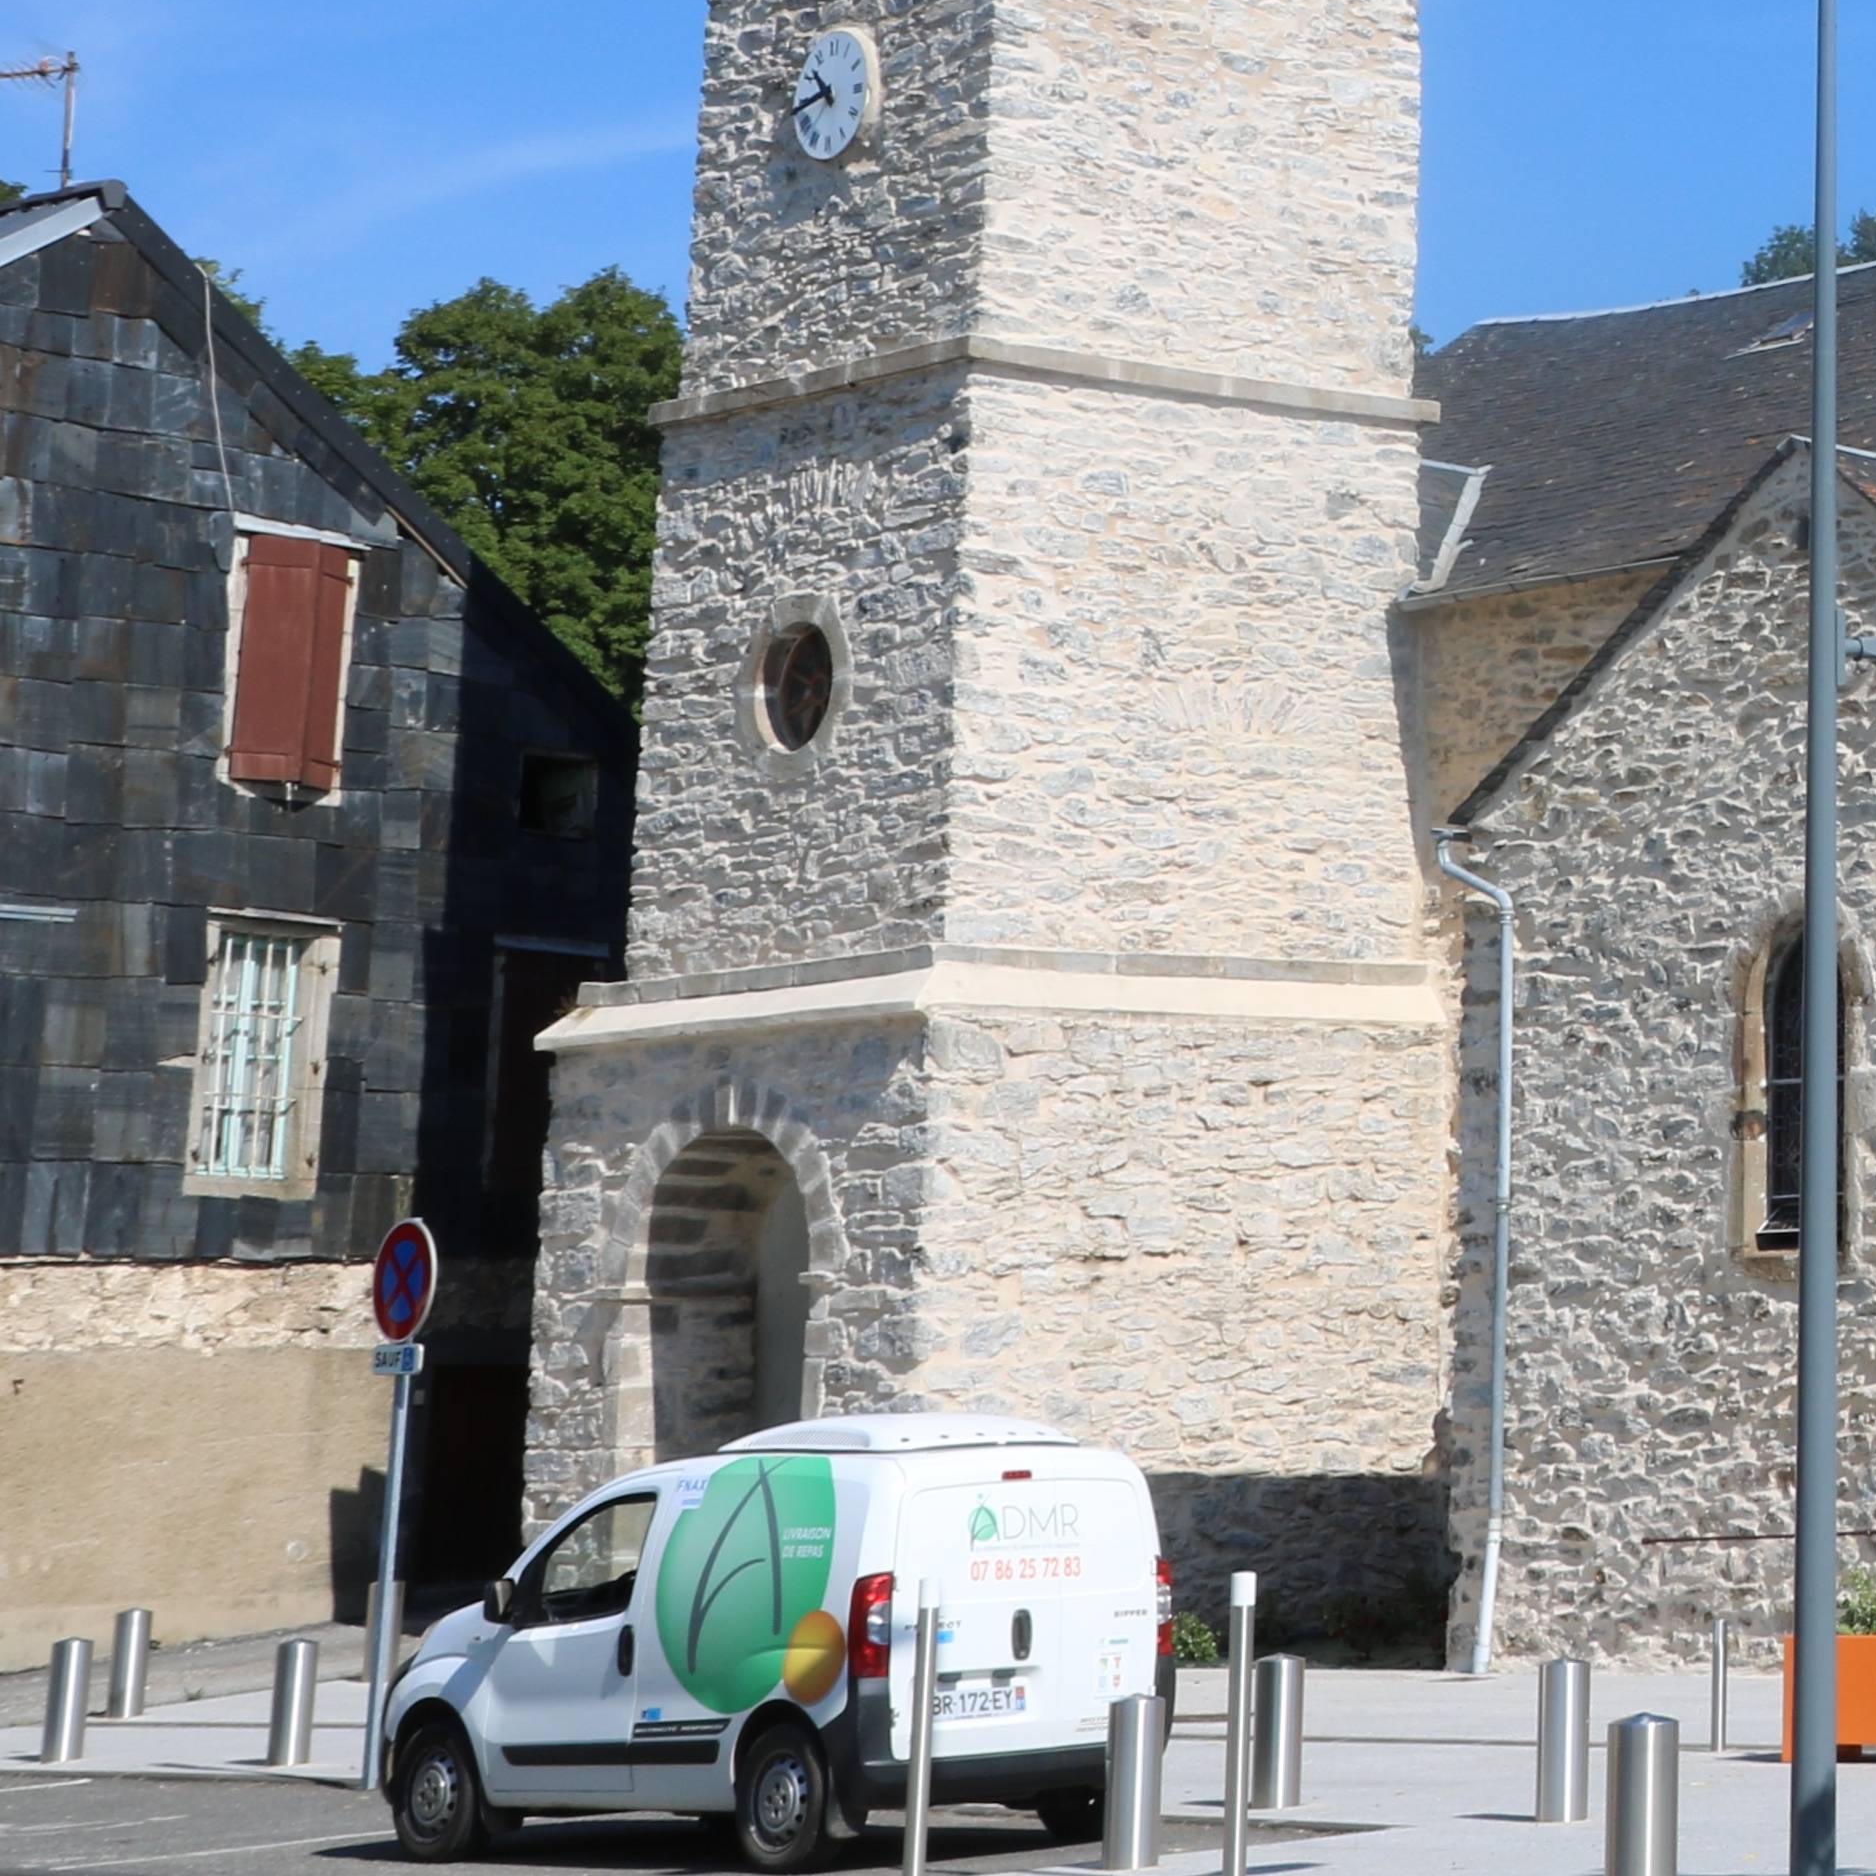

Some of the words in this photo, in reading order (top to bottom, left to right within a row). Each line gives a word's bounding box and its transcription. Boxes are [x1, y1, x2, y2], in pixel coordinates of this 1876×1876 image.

[375, 1350, 401, 1368] SAUF
[782, 1527, 832, 1541] LIVRAISON
[970, 1560, 989, 1582] 07
[995, 1559, 1014, 1581] 86
[1019, 1558, 1037, 1579] 25
[1042, 1556, 1060, 1577] 72
[1063, 1555, 1082, 1577] 83
